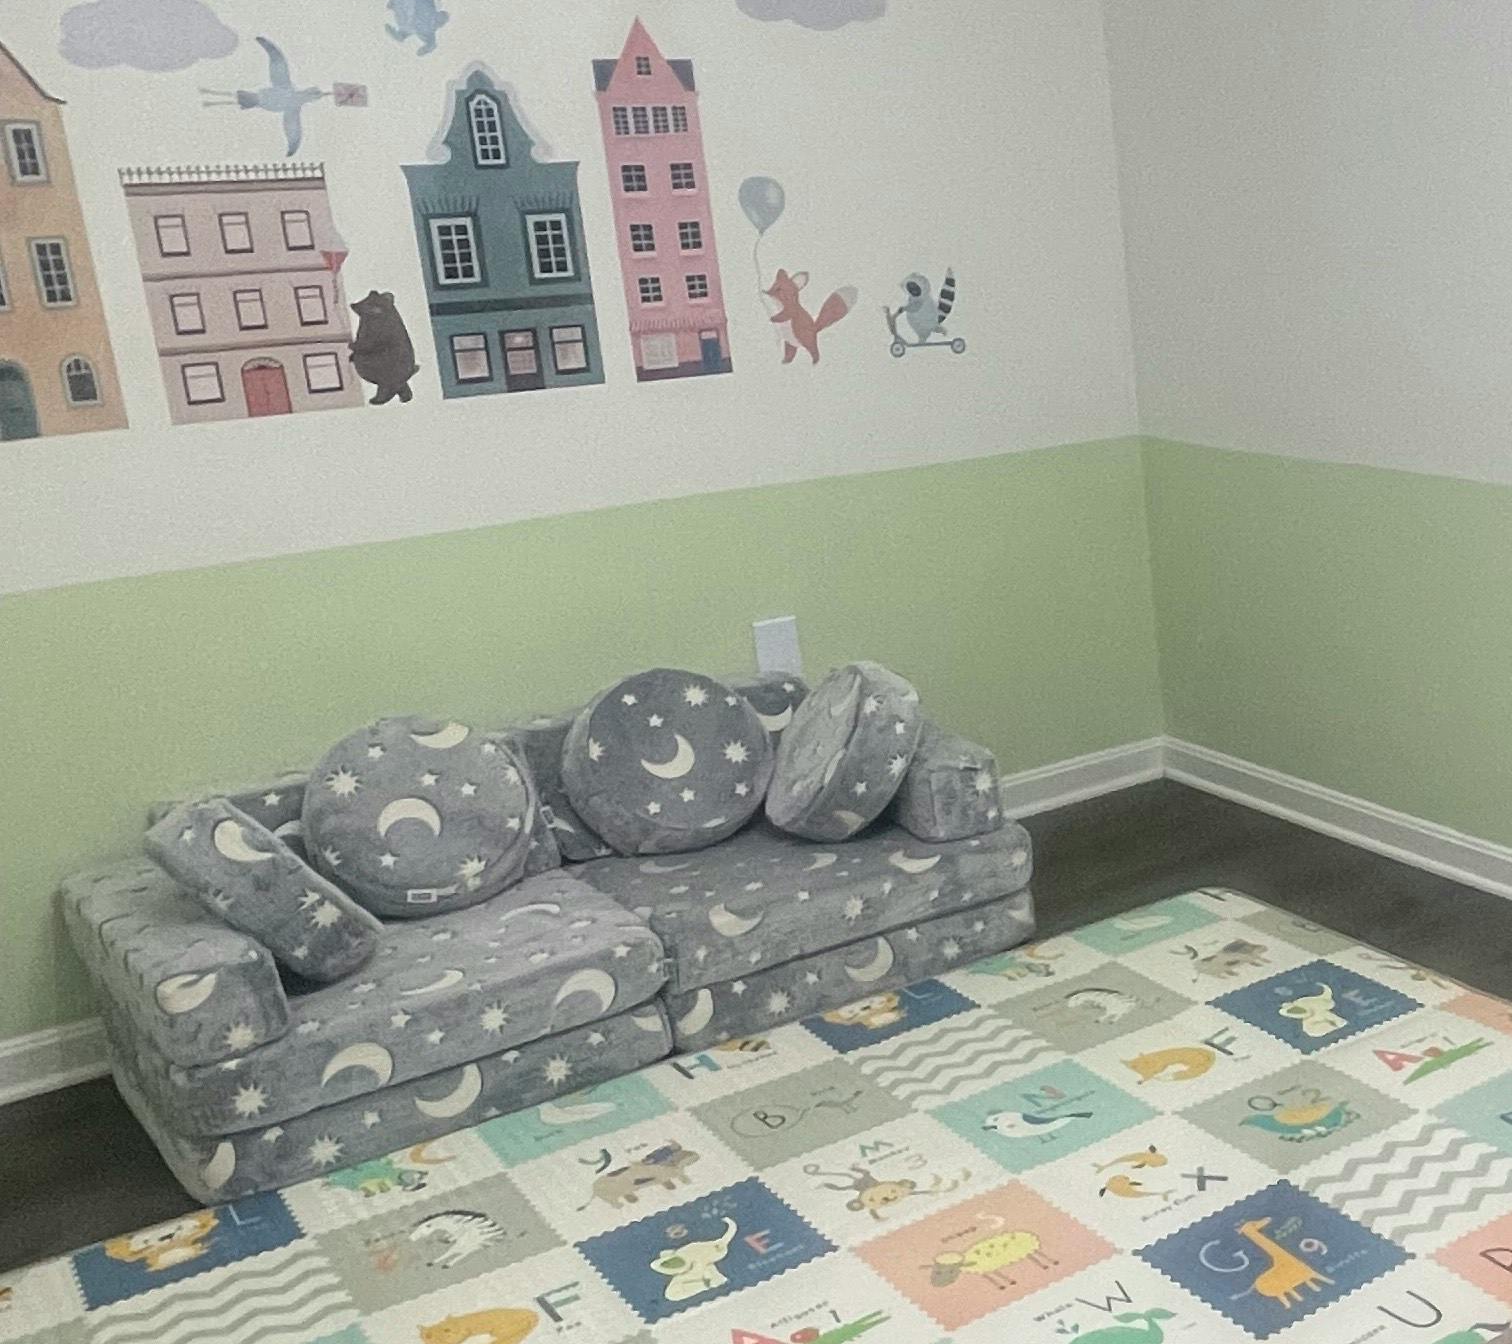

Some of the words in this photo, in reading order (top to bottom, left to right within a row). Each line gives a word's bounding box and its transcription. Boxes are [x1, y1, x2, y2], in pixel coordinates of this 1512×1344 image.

[1203, 1026, 1237, 1056] F
[671, 1054, 723, 1080] H
[1373, 1048, 1425, 1072] A
[1247, 1095, 1283, 1112] Q
[753, 1110, 787, 1131] B
[858, 1140, 895, 1158] M
[1180, 1166, 1229, 1191] X
[974, 1212, 1006, 1230] S
[744, 1229, 785, 1255] E
[1298, 1237, 1329, 1256] 9
[1199, 1239, 1250, 1273] G
[535, 1280, 582, 1324] F
[1074, 1280, 1134, 1314] W
[1377, 1290, 1443, 1329] U
